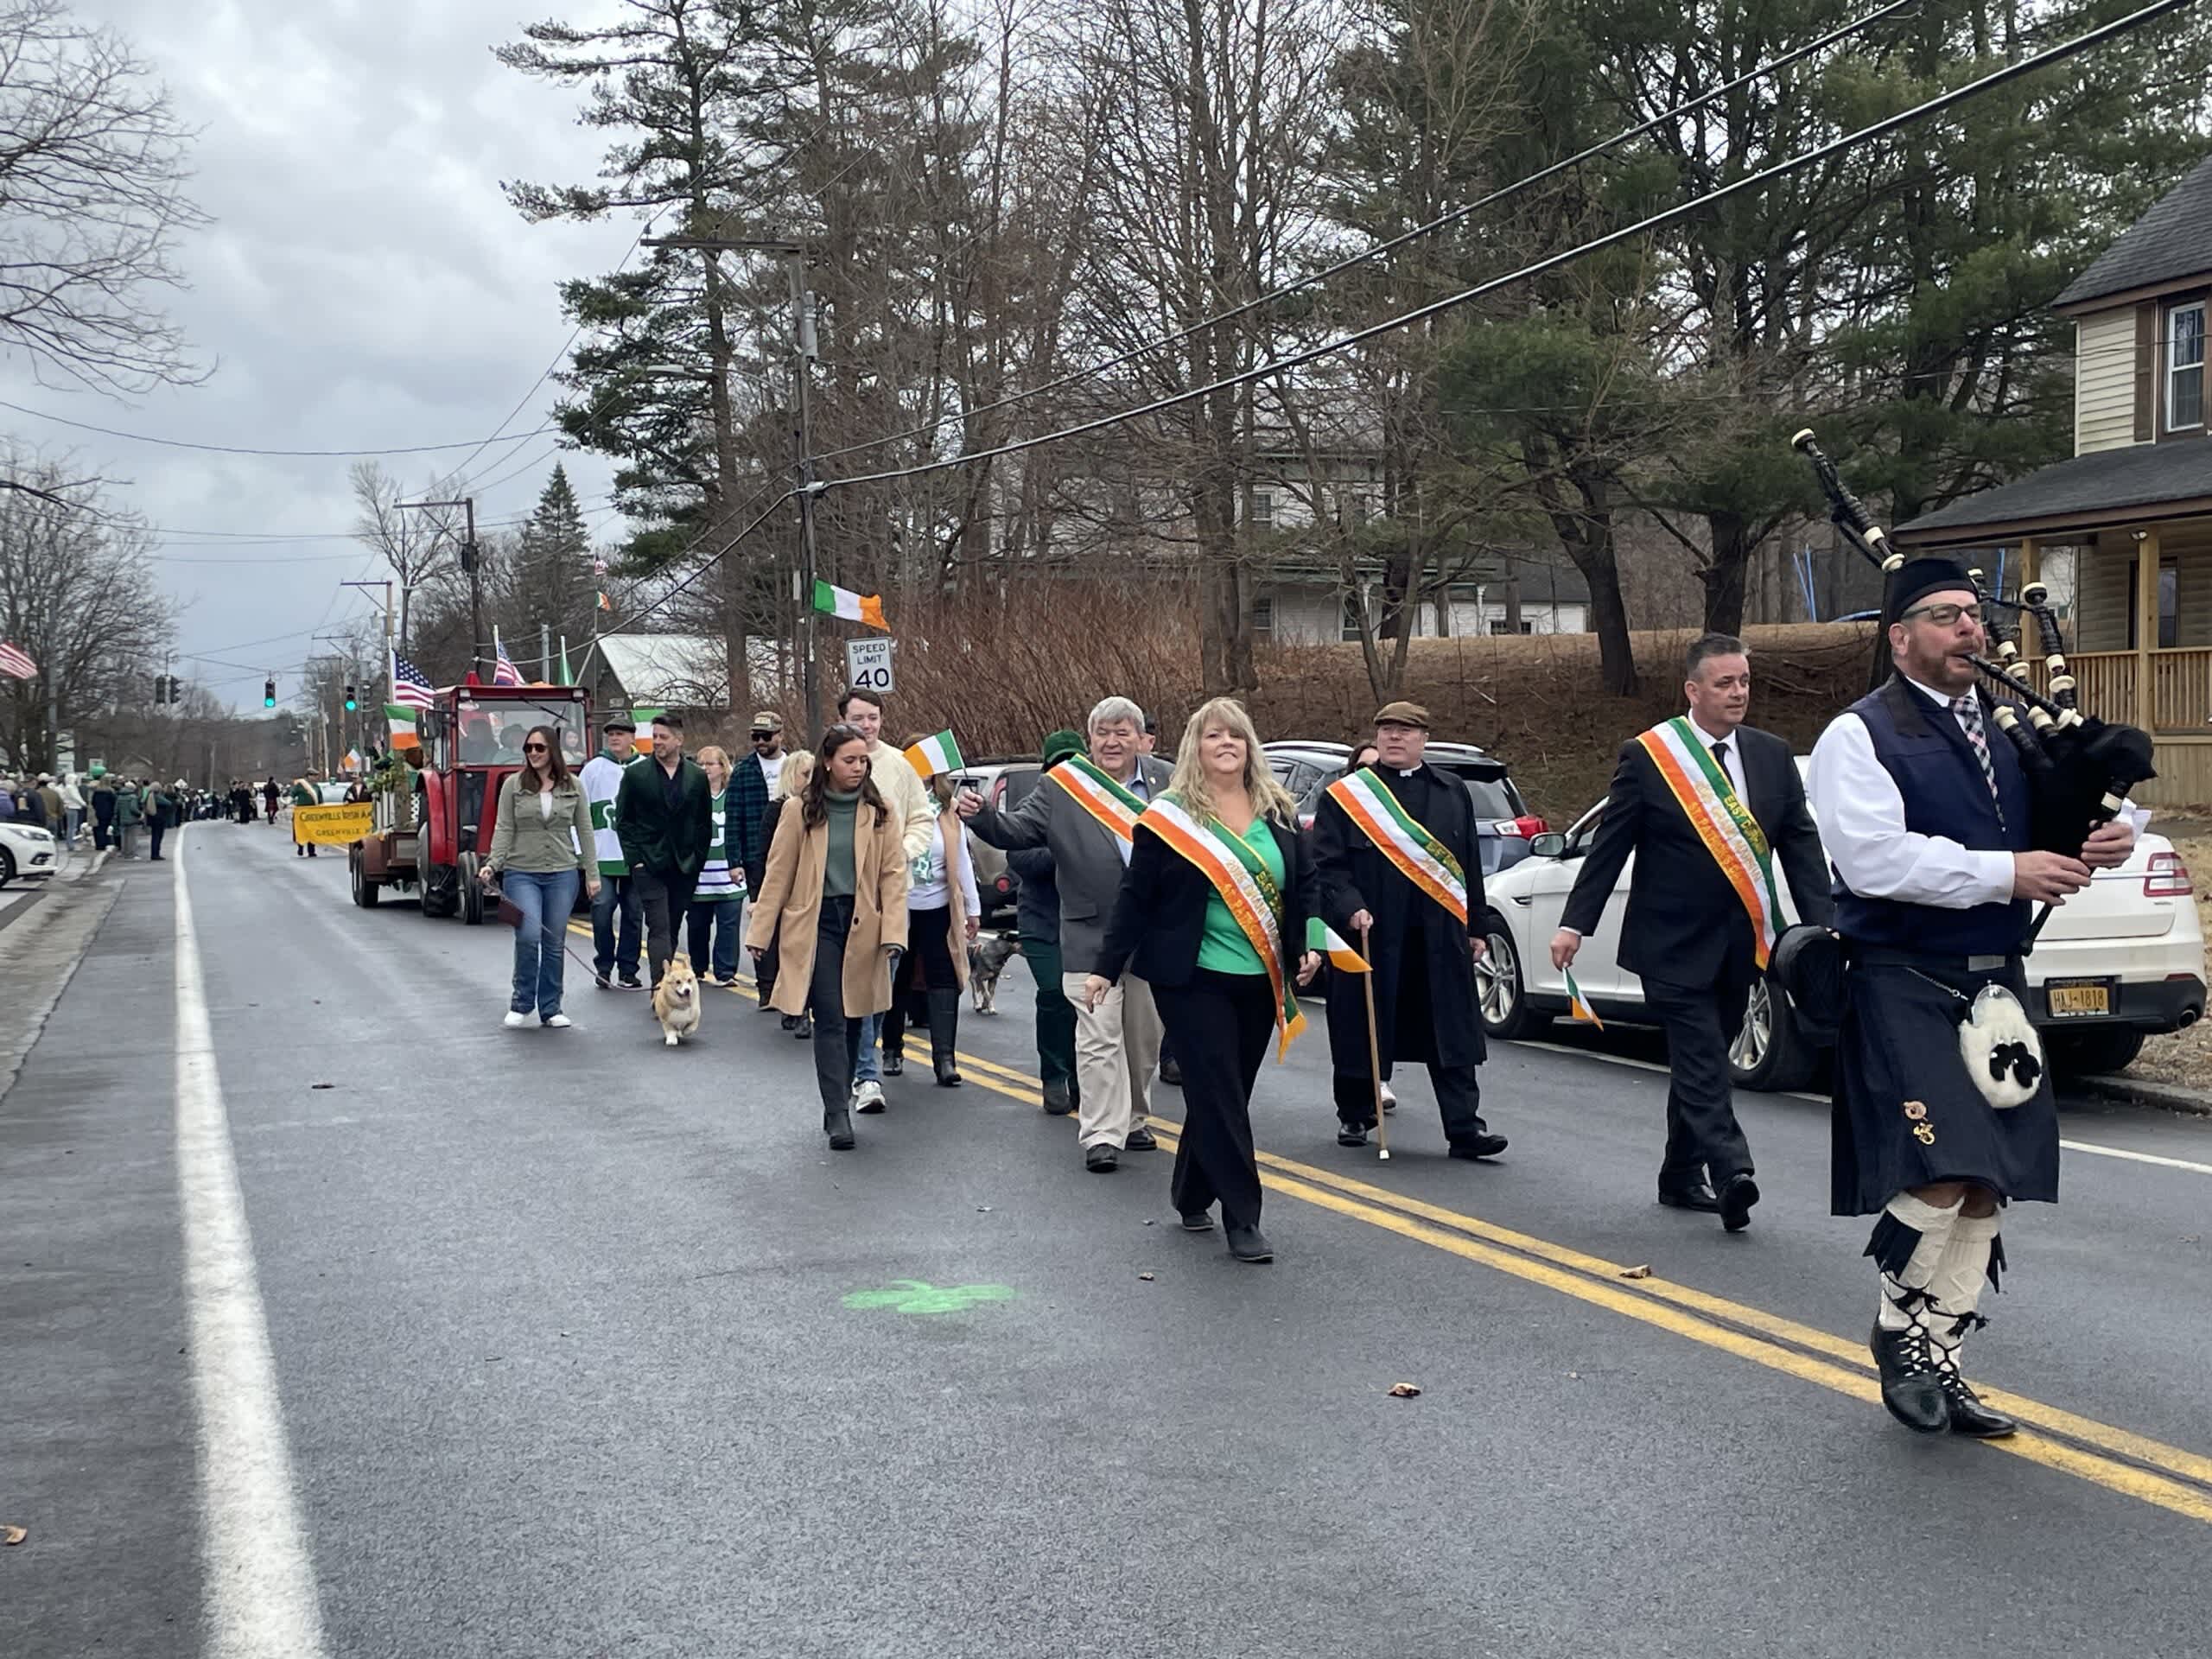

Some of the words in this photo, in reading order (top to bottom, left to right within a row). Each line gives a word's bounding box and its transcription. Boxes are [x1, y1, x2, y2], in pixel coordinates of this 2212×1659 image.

[853, 644, 886, 654] SPEED
[857, 655, 881, 664] LIMIT
[855, 668, 889, 689] 40
[1725, 795, 1746, 816] EAST
